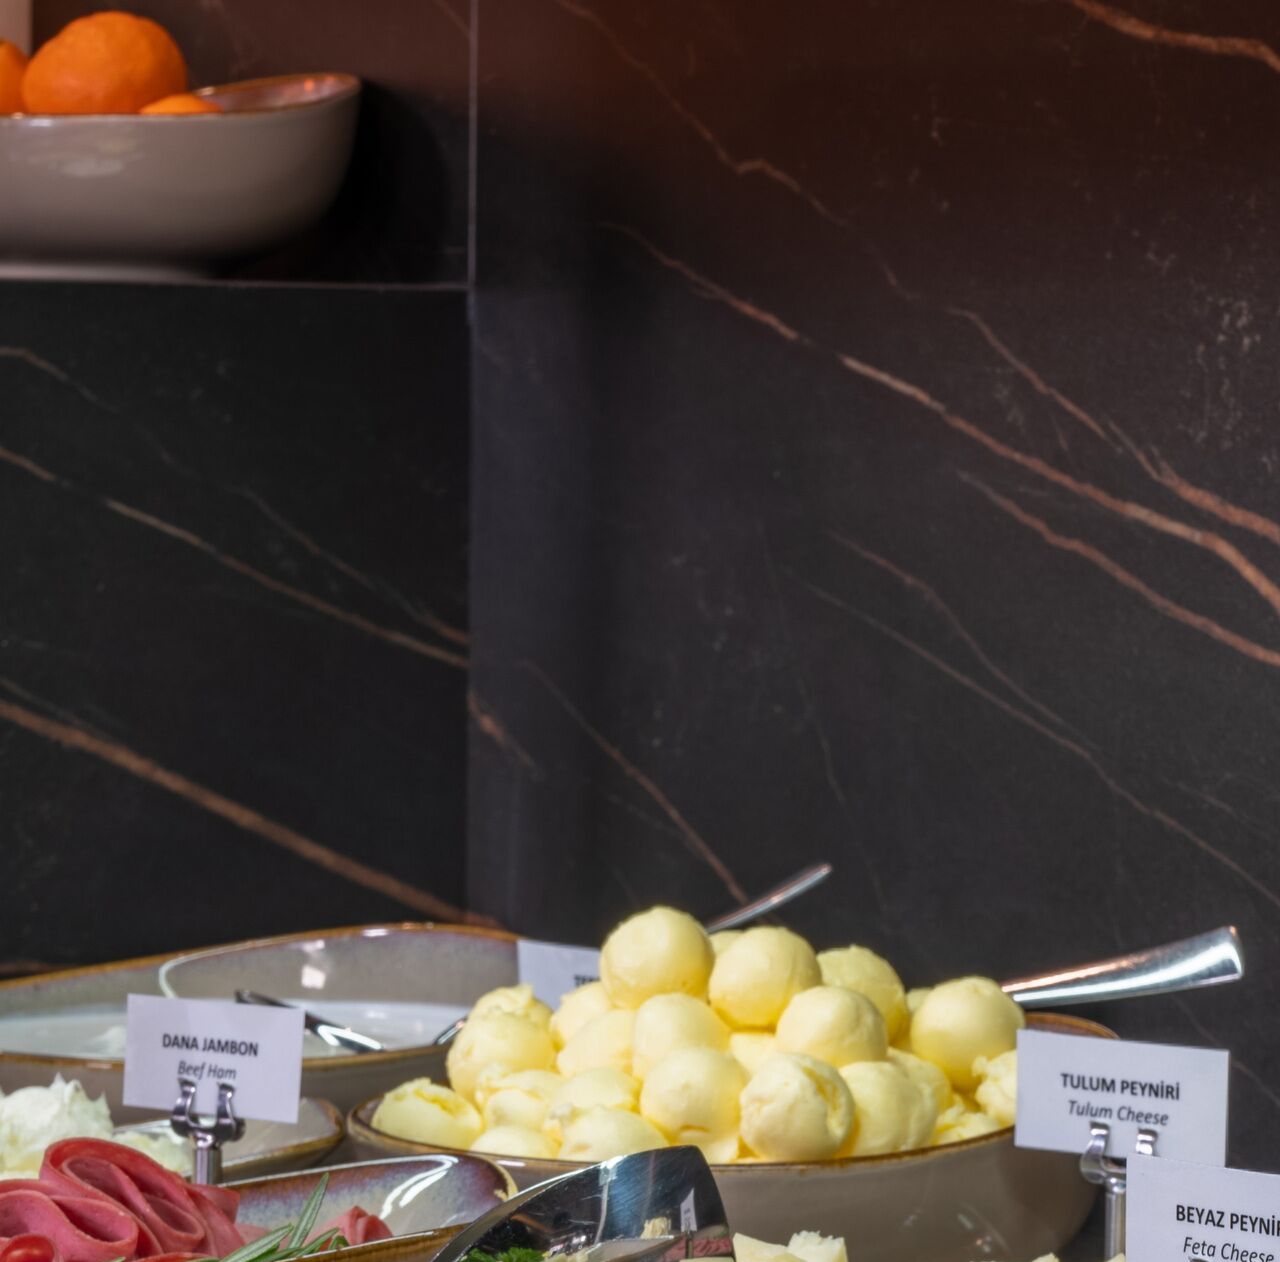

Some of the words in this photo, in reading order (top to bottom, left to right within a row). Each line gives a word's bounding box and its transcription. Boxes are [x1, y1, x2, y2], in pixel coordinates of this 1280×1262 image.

[162, 1033, 199, 1051] DANA
[202, 1037, 259, 1057] JAMBON
[177, 1060, 206, 1080] Beef
[207, 1065, 237, 1080] Ham
[1060, 1073, 1116, 1093] TULUM
[1120, 1079, 1180, 1101] PEYNİRİ
[1068, 1100, 1113, 1119] Tulum
[1117, 1105, 1169, 1126] Cheese
[1176, 1204, 1225, 1228] BEYAZ
[1183, 1236, 1216, 1257] Feta
